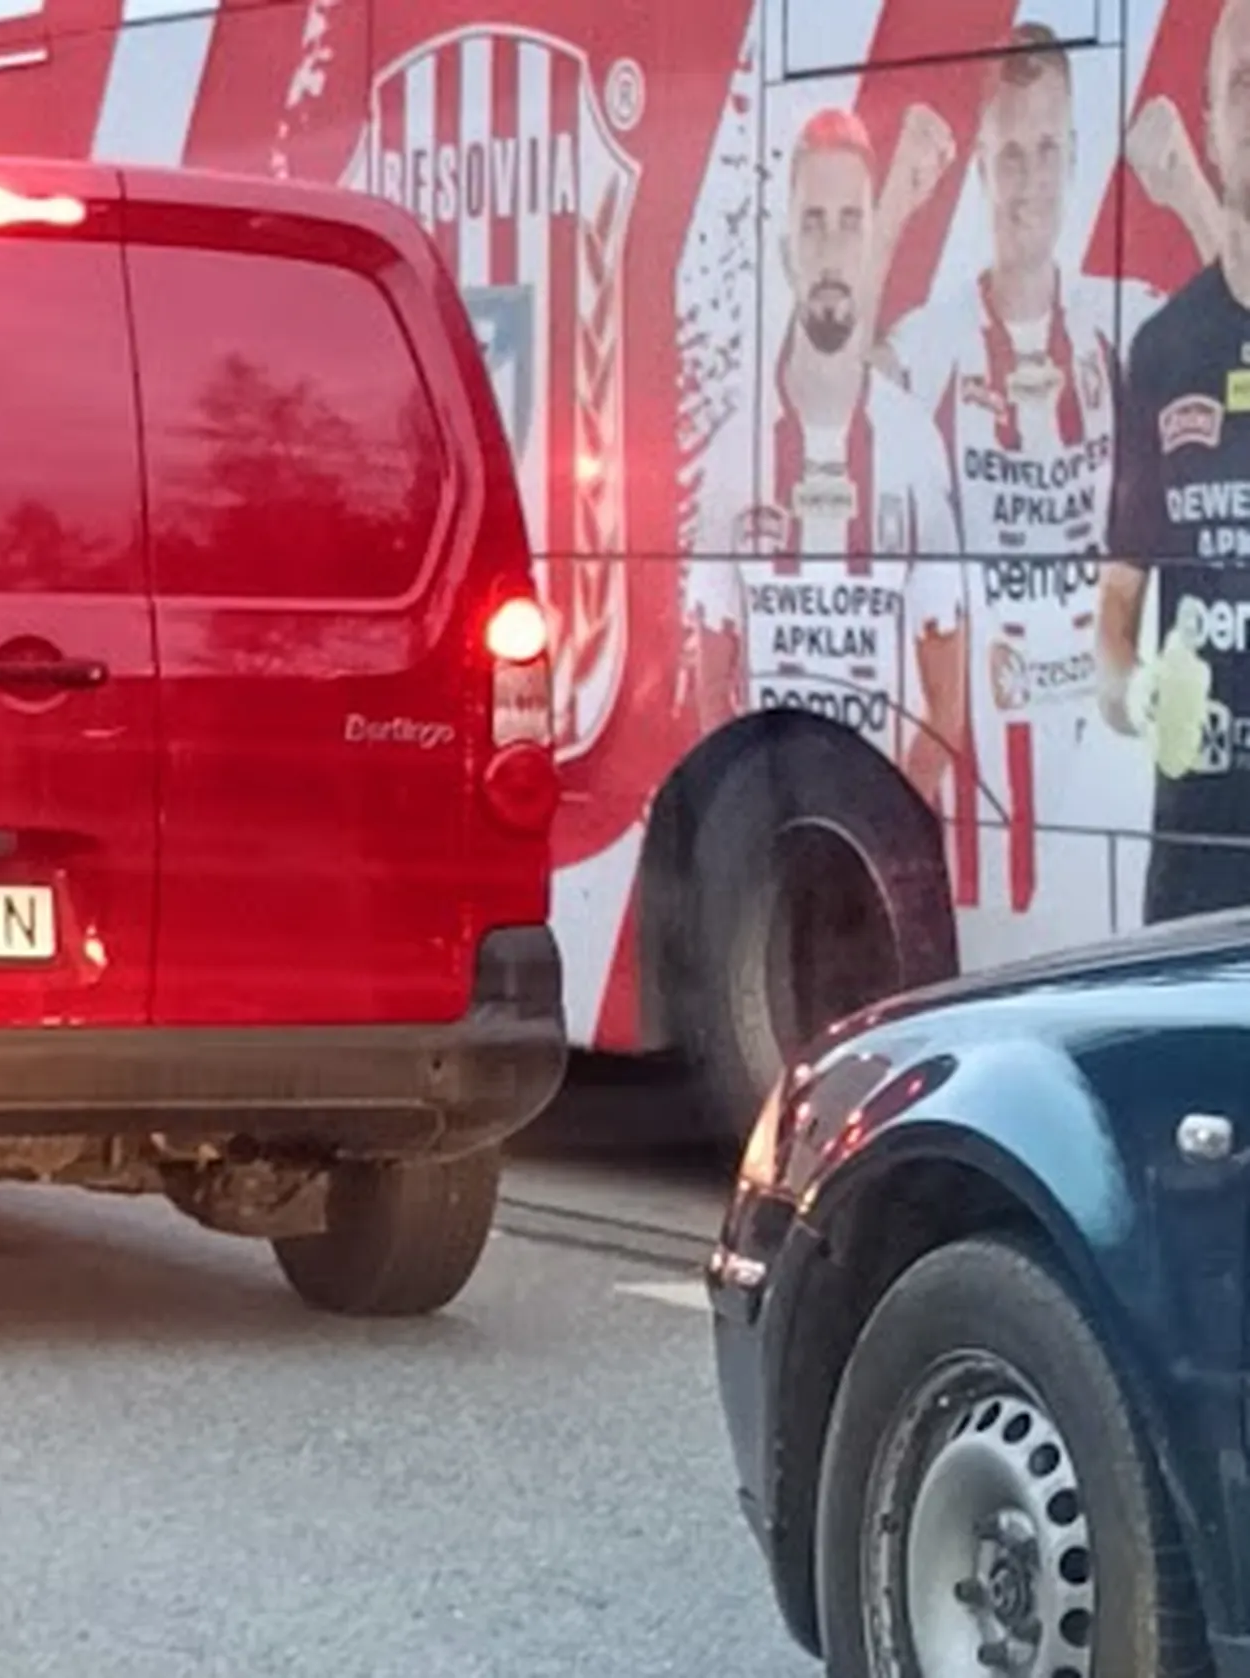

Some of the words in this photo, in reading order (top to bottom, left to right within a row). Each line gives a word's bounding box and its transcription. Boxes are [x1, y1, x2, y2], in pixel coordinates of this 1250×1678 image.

[382, 132, 577, 224] RESOVIA
[964, 434, 1109, 490] DEWELOPER
[992, 488, 1095, 525] APKLAN
[773, 625, 877, 658] APKLAN
